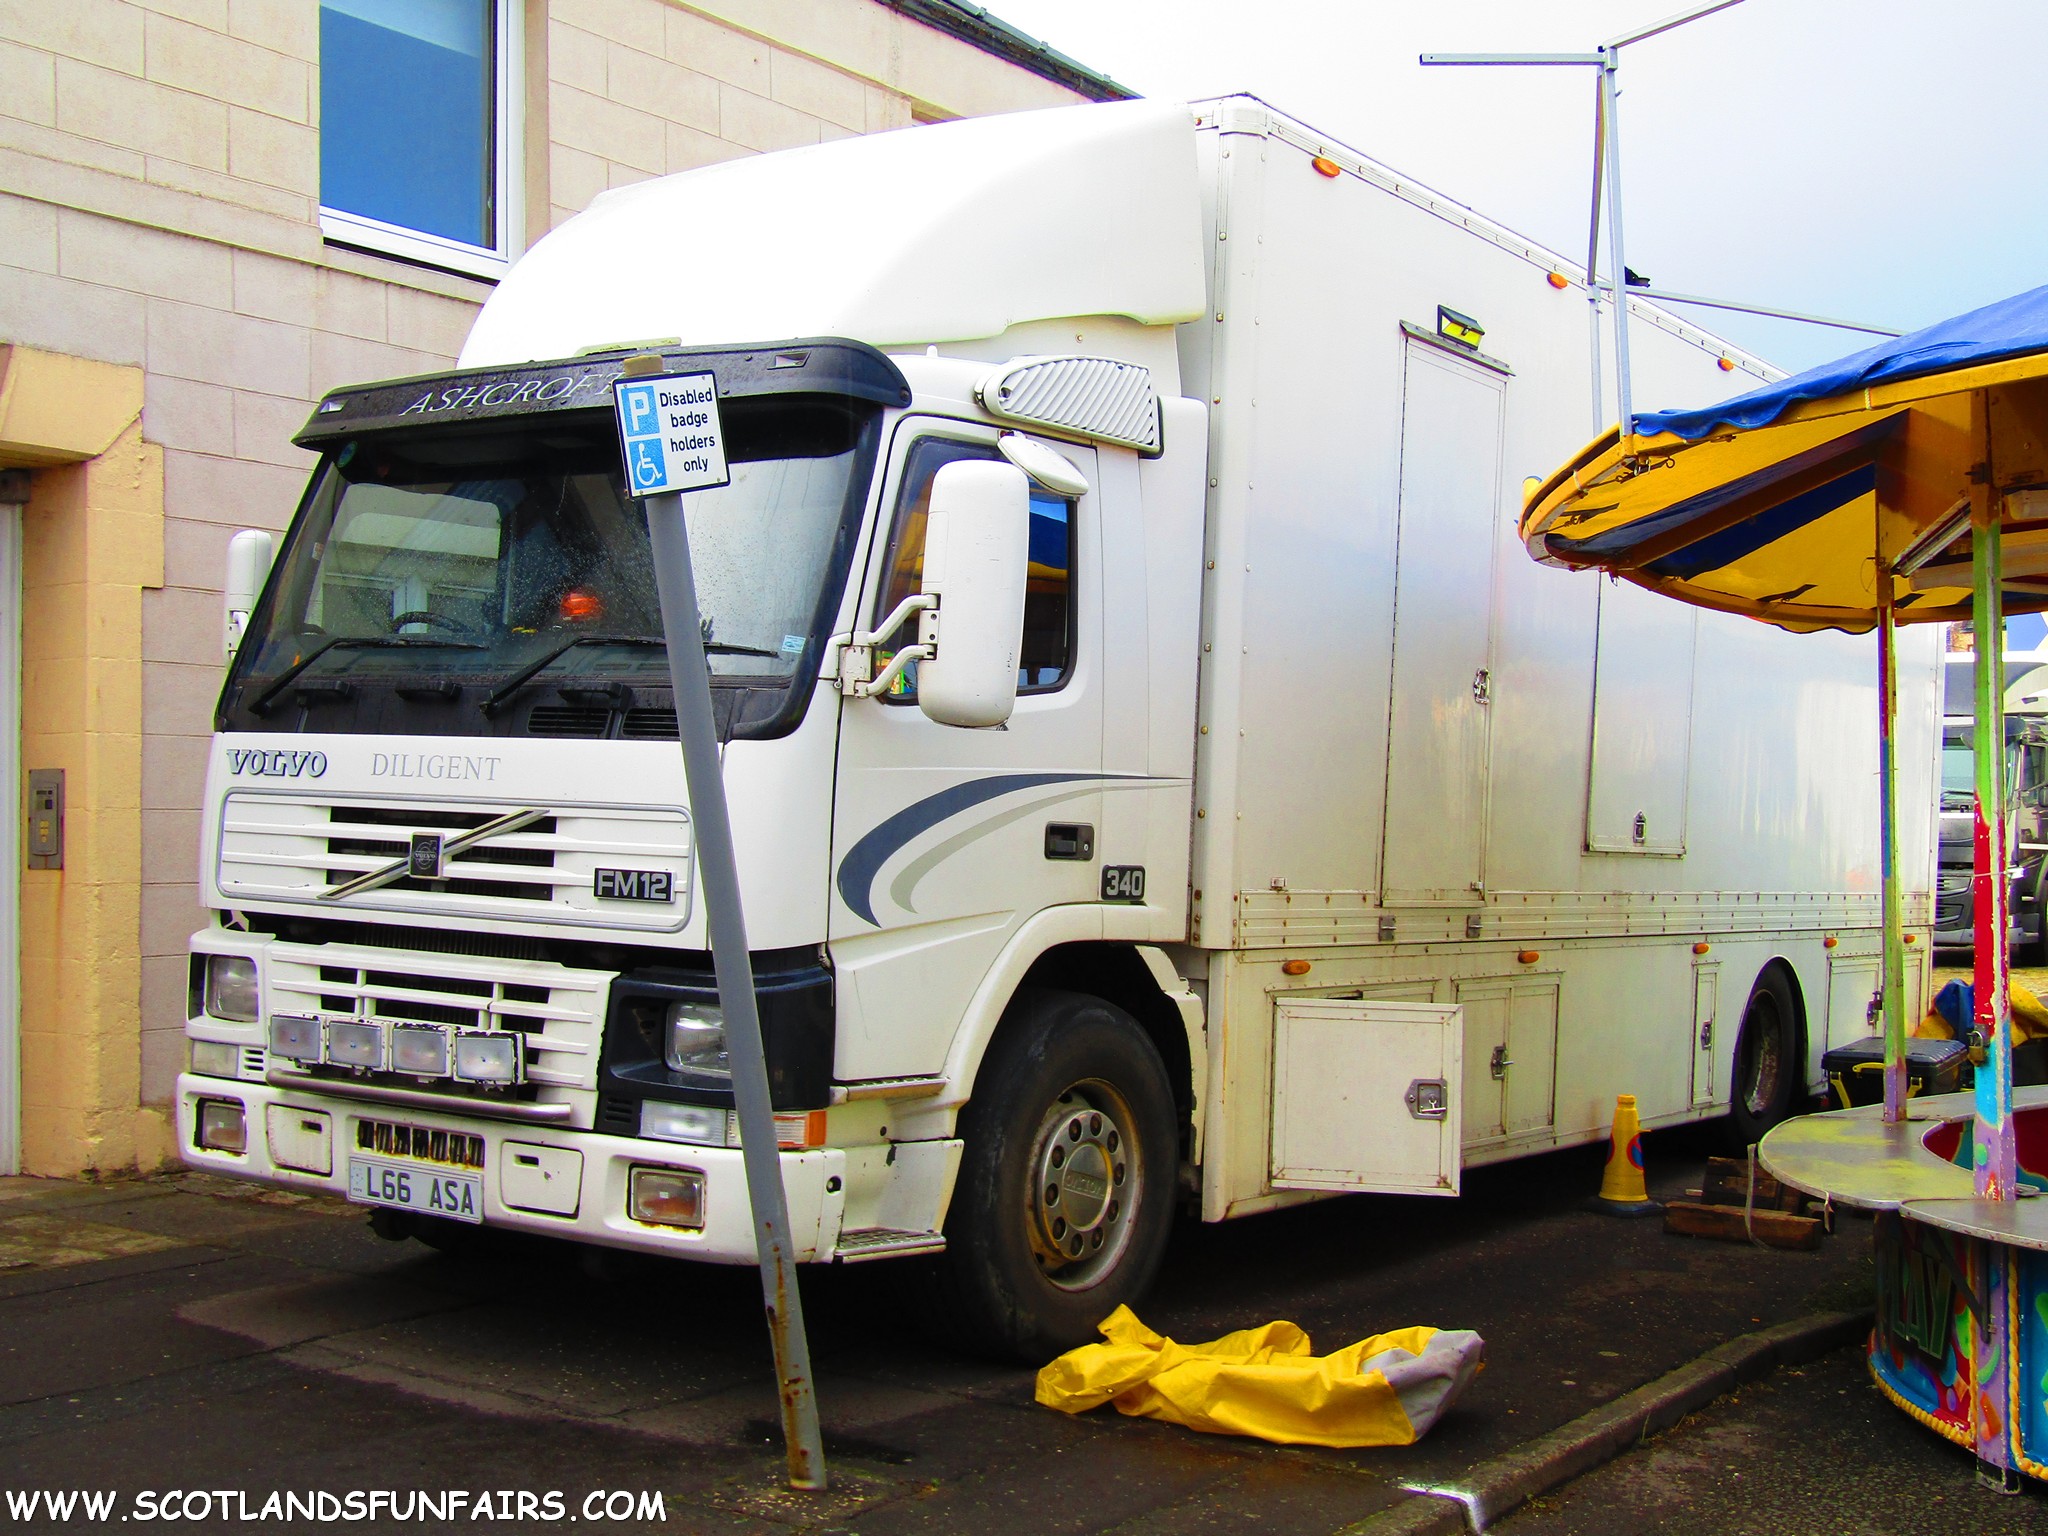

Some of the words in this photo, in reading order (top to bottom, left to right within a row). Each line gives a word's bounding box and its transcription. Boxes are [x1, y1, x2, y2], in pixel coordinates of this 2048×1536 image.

[659, 388, 713, 408] Disabled
[670, 411, 709, 428] badge
[670, 434, 716, 453] holders
[683, 455, 709, 473] only
[226, 748, 328, 778] VOLVO
[370, 752, 502, 781] DILIGENT
[597, 870, 668, 900] FM12
[1106, 869, 1143, 896] 340
[366, 1166, 412, 1203] L66
[429, 1177, 475, 1215] ASA
